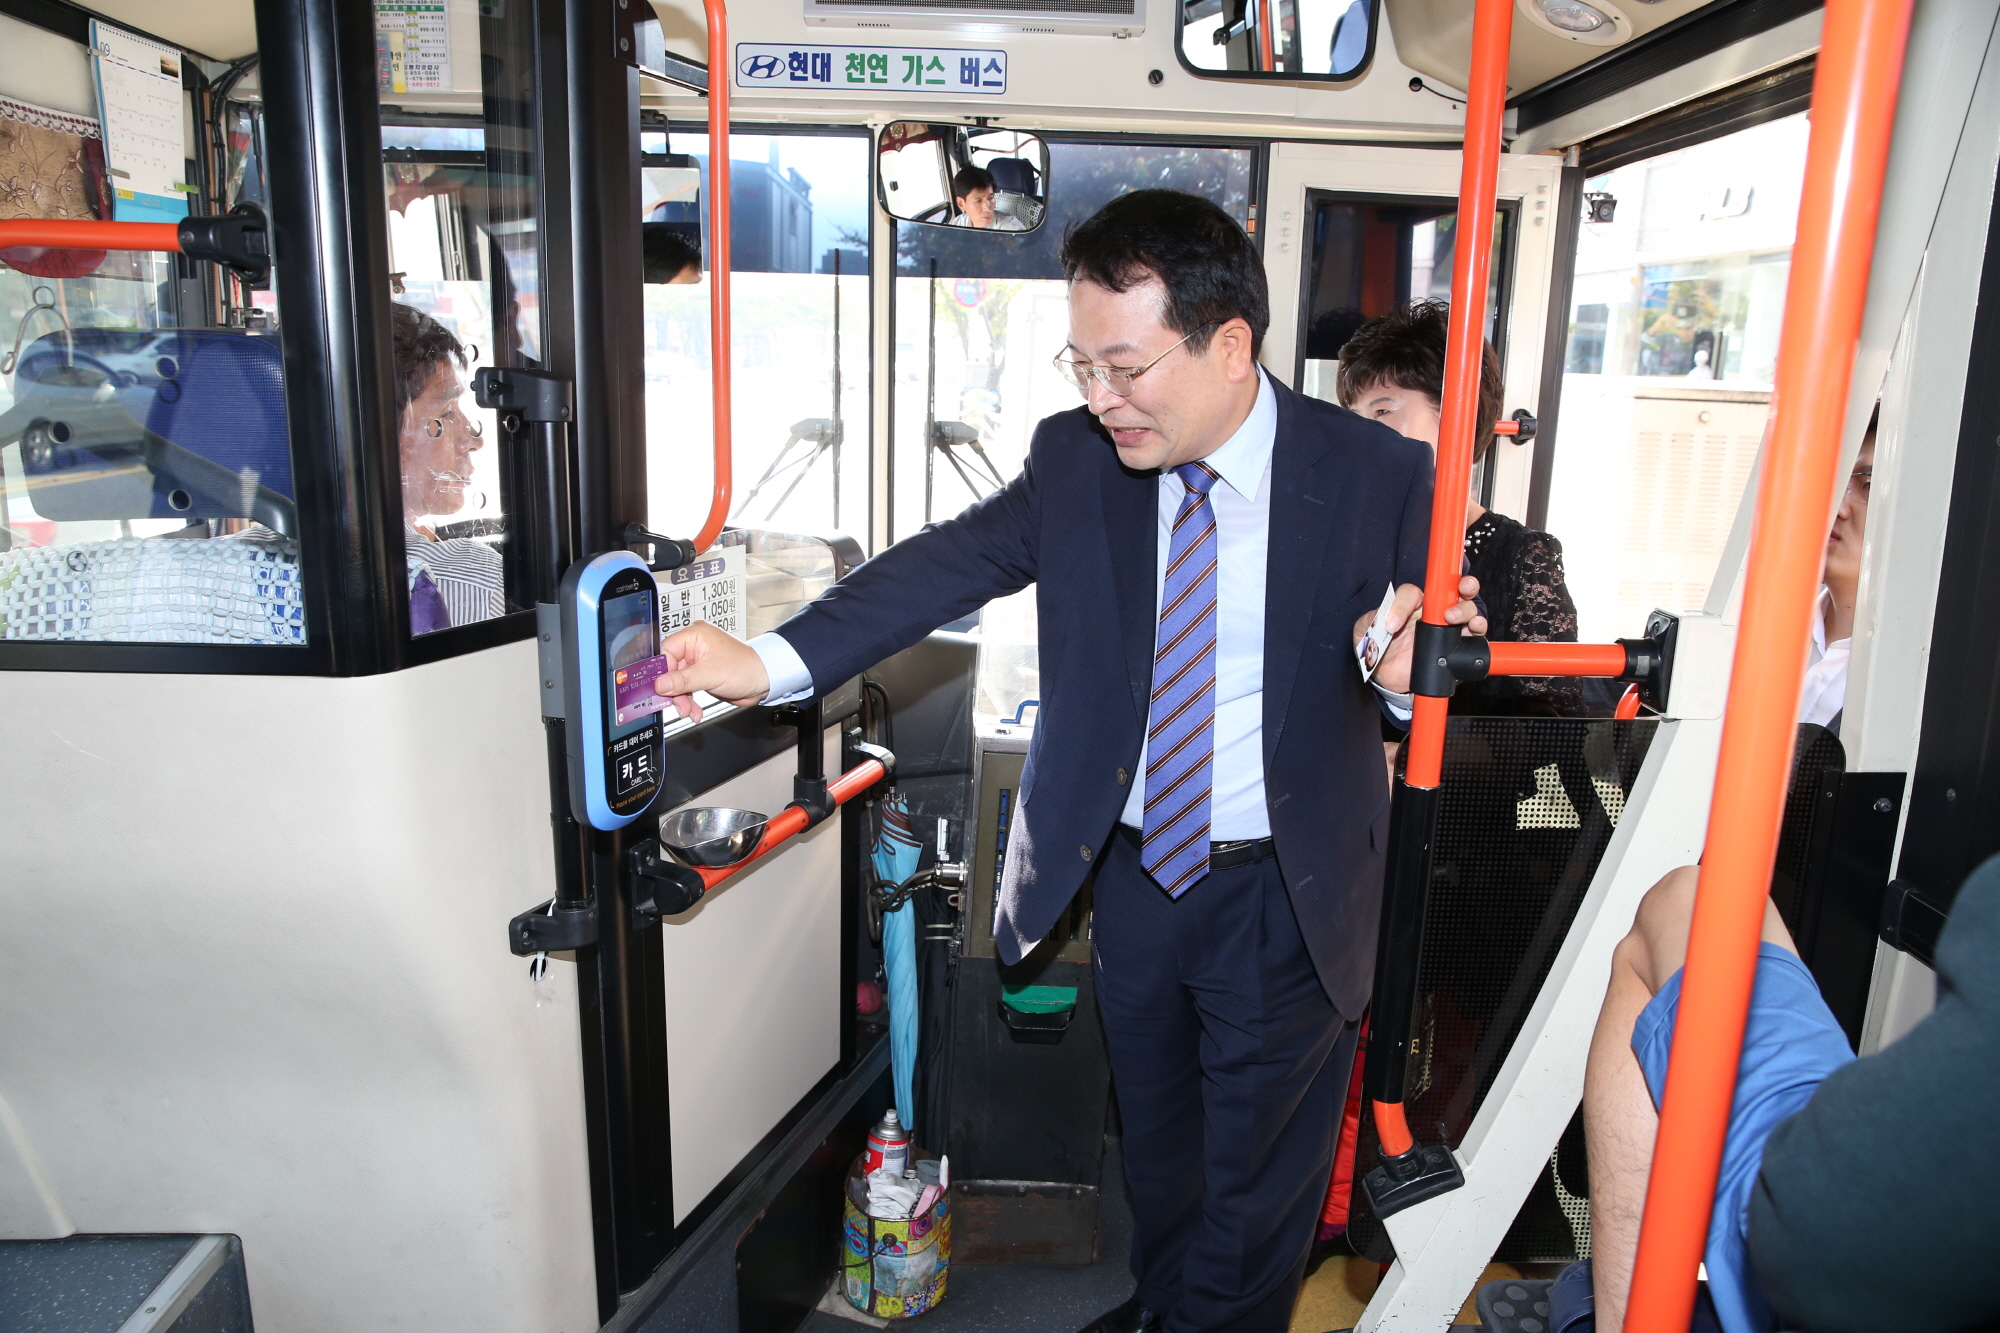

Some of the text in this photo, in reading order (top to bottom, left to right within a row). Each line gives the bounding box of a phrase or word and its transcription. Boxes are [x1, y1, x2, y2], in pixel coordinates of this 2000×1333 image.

[788, 51, 1003, 87] 현대 천연 가스 버스
[676, 560, 721, 583] 요금표
[702, 578, 736, 602] 1,300원
[660, 608, 691, 633] 중고생
[702, 597, 736, 620] 1,050원
[639, 729, 653, 741] 주세요
[622, 754, 648, 779] 카드
[630, 776, 643, 787] CARD
[616, 785, 656, 809] Place your card here
